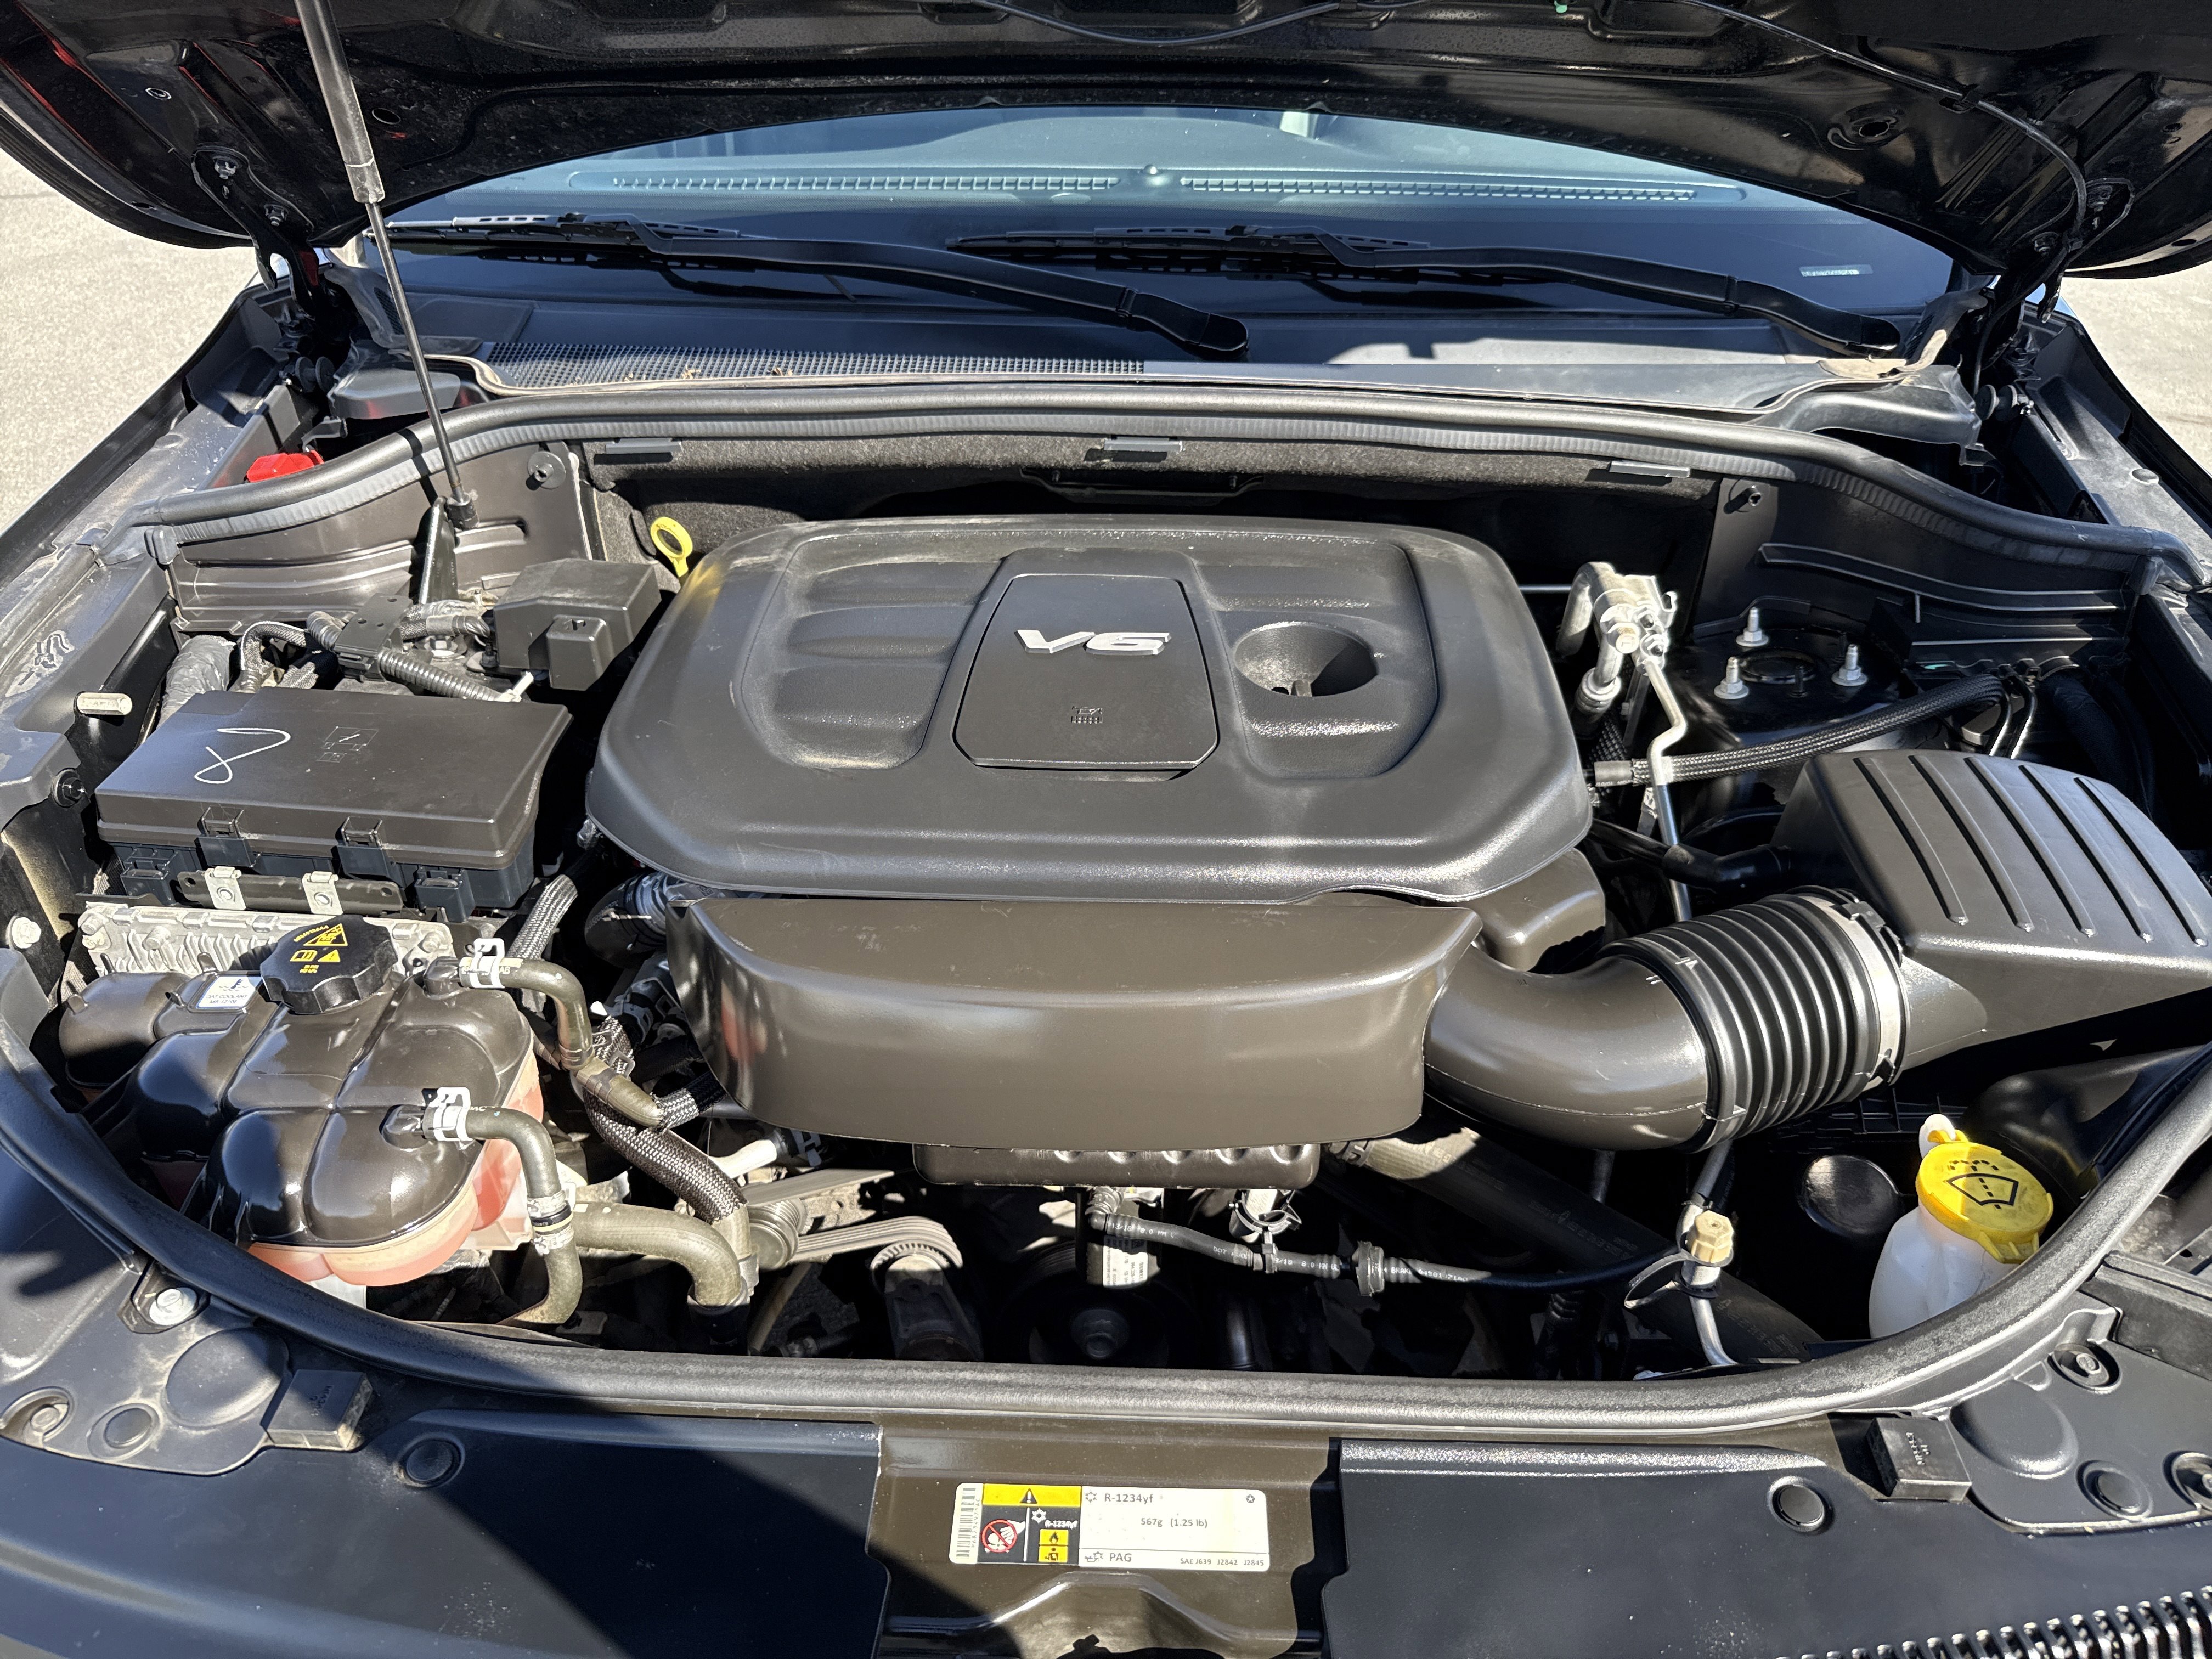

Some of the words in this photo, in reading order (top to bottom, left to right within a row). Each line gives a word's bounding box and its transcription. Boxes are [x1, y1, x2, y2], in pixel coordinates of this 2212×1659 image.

[1014, 629, 1172, 655] V6
[1213, 1246, 1227, 1255] DOT
[1104, 1493, 1154, 1505] R-1234yf
[1045, 1520, 1078, 1530] R-1234yf
[1141, 1517, 1163, 1527] 567g
[1170, 1517, 1193, 1528] (1.25
[1195, 1519, 1207, 1529] lb)
[1109, 1553, 1132, 1562] PAG
